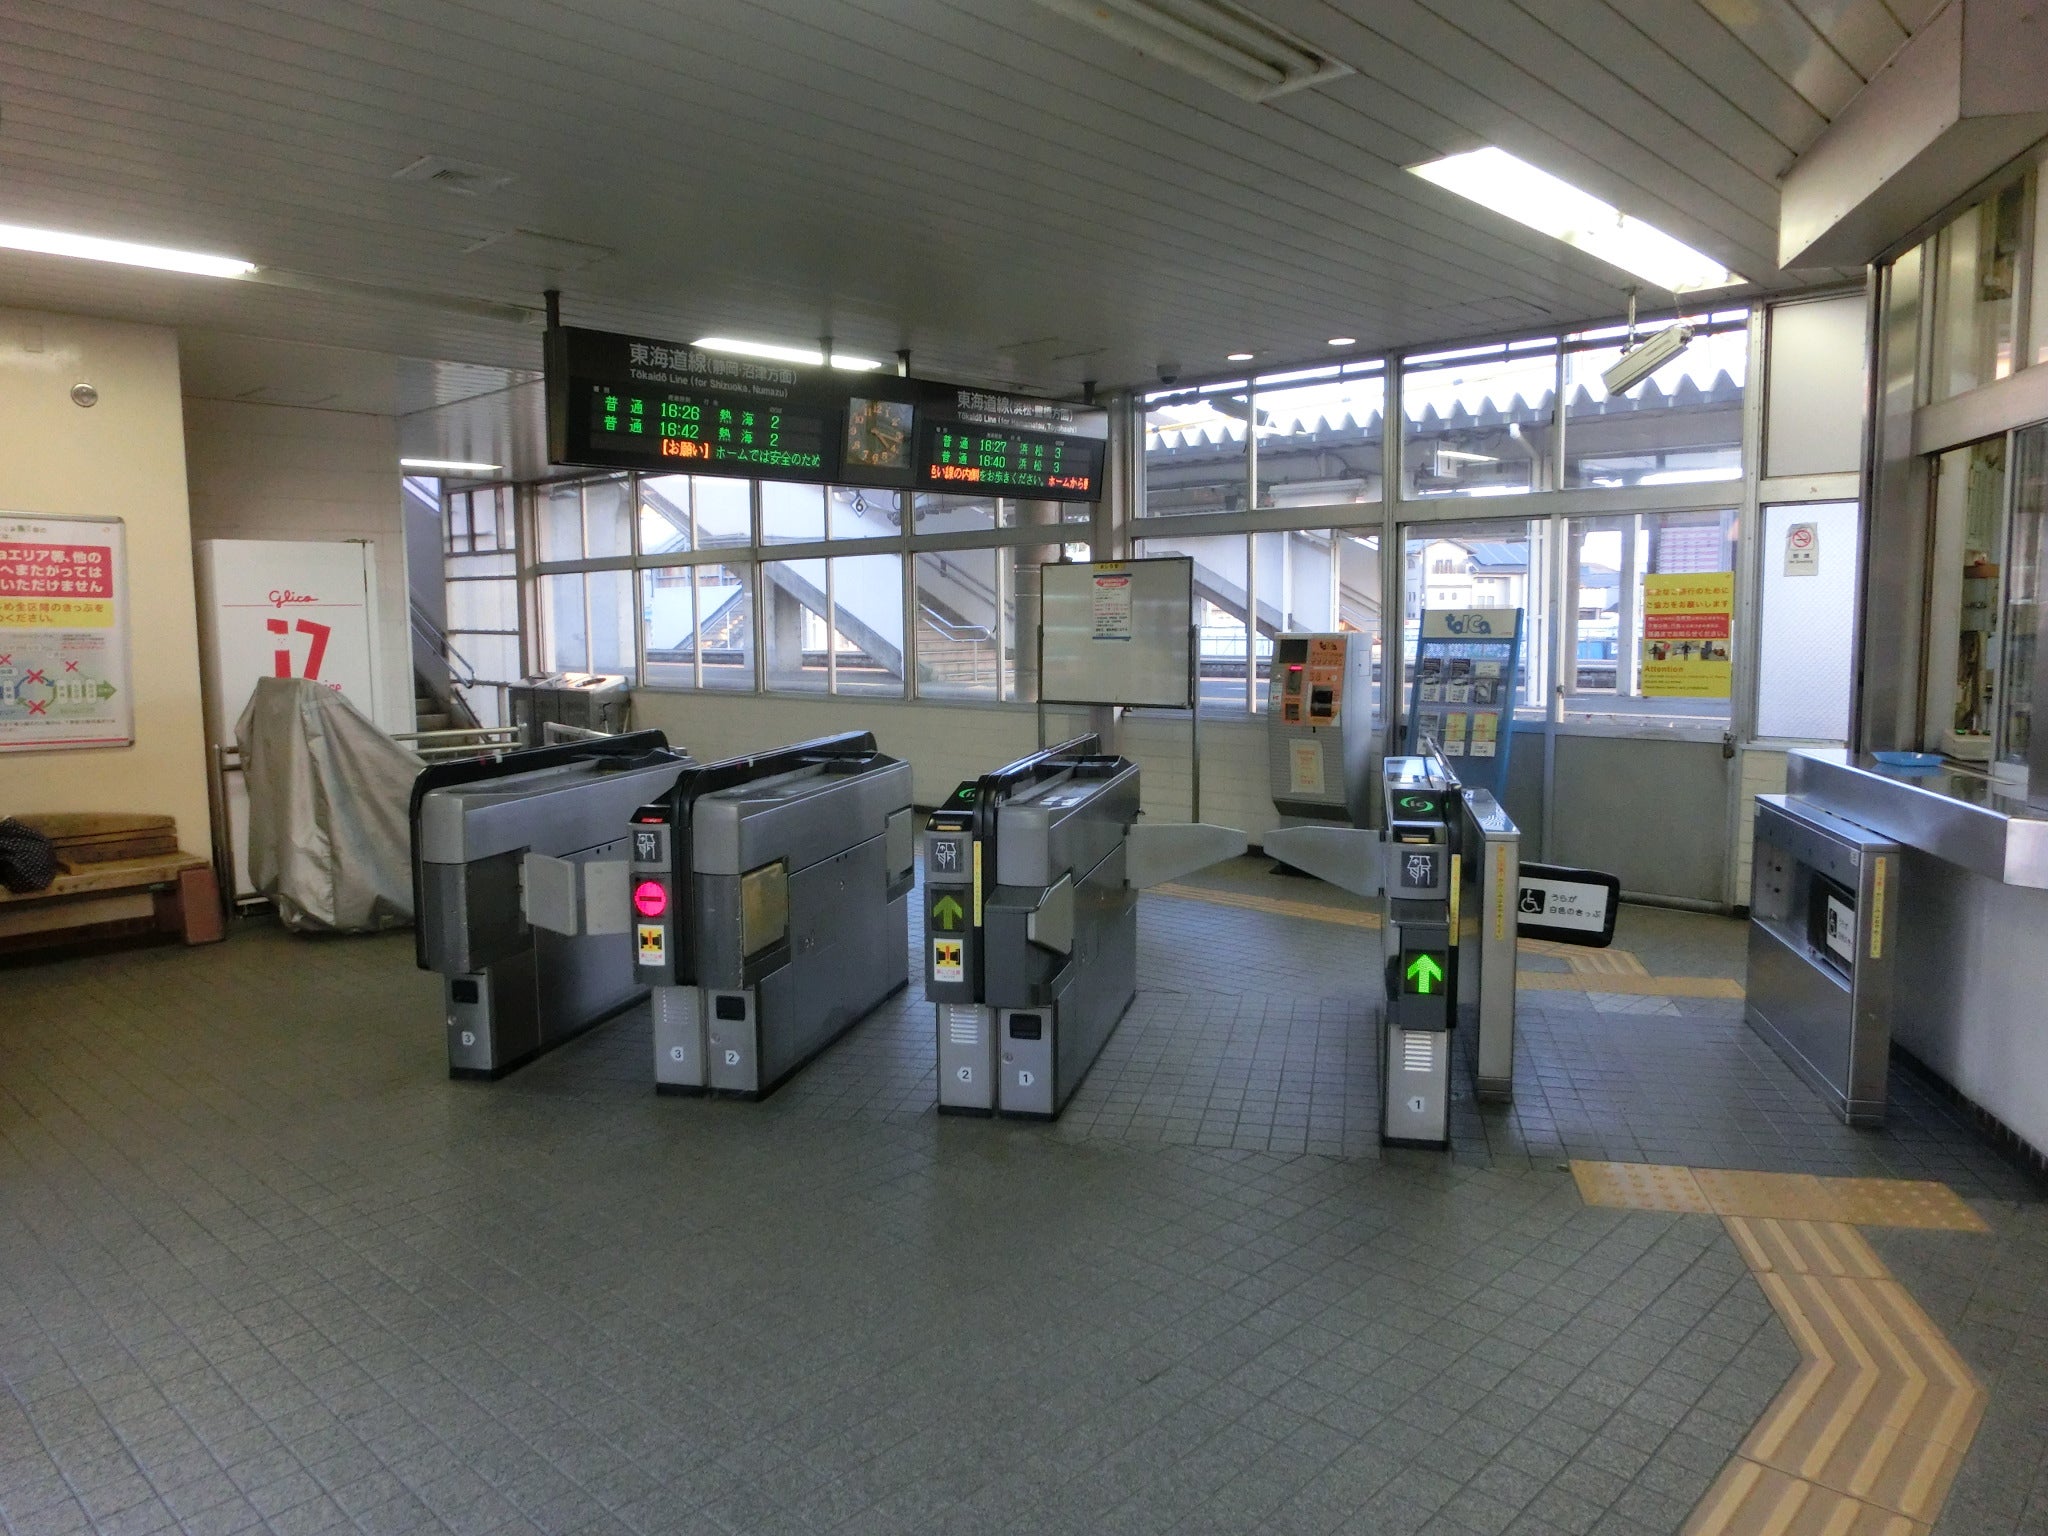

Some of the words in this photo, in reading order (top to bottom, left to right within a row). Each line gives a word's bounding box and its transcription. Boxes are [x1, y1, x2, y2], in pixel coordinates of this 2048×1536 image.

[670, 373, 688, 385] Line
[690, 376, 708, 389] (for
[752, 384, 789, 399] Numazu)
[604, 395, 644, 415] 普通
[660, 402, 701, 421] 16:26
[719, 409, 755, 427] 熱海
[770, 415, 780, 430] 2
[603, 414, 643, 434] 普通
[660, 422, 699, 440] 16:42
[718, 427, 754, 445] 熱海
[770, 433, 779, 448] 2
[942, 434, 969, 451] 普通
[980, 439, 1007, 454] 16:27
[1054, 448, 1062, 459] 3
[715, 446, 821, 467] ホームでは安全のため
[941, 450, 968, 466] 普通
[979, 454, 1006, 469] 16:40
[1053, 461, 1060, 474] 3
[854, 498, 864, 511] 6
[0, 566, 103, 579] へまたがっては
[0, 579, 104, 593] いただけません
[269, 590, 319, 608] Glico
[1645, 665, 1684, 673] Attention
[465, 1034, 471, 1043] 3
[674, 1049, 682, 1059] 3
[728, 1053, 735, 1063] 2
[962, 1069, 969, 1080] 2
[1022, 1073, 1028, 1084] 1
[1415, 1100, 1420, 1109] 1
